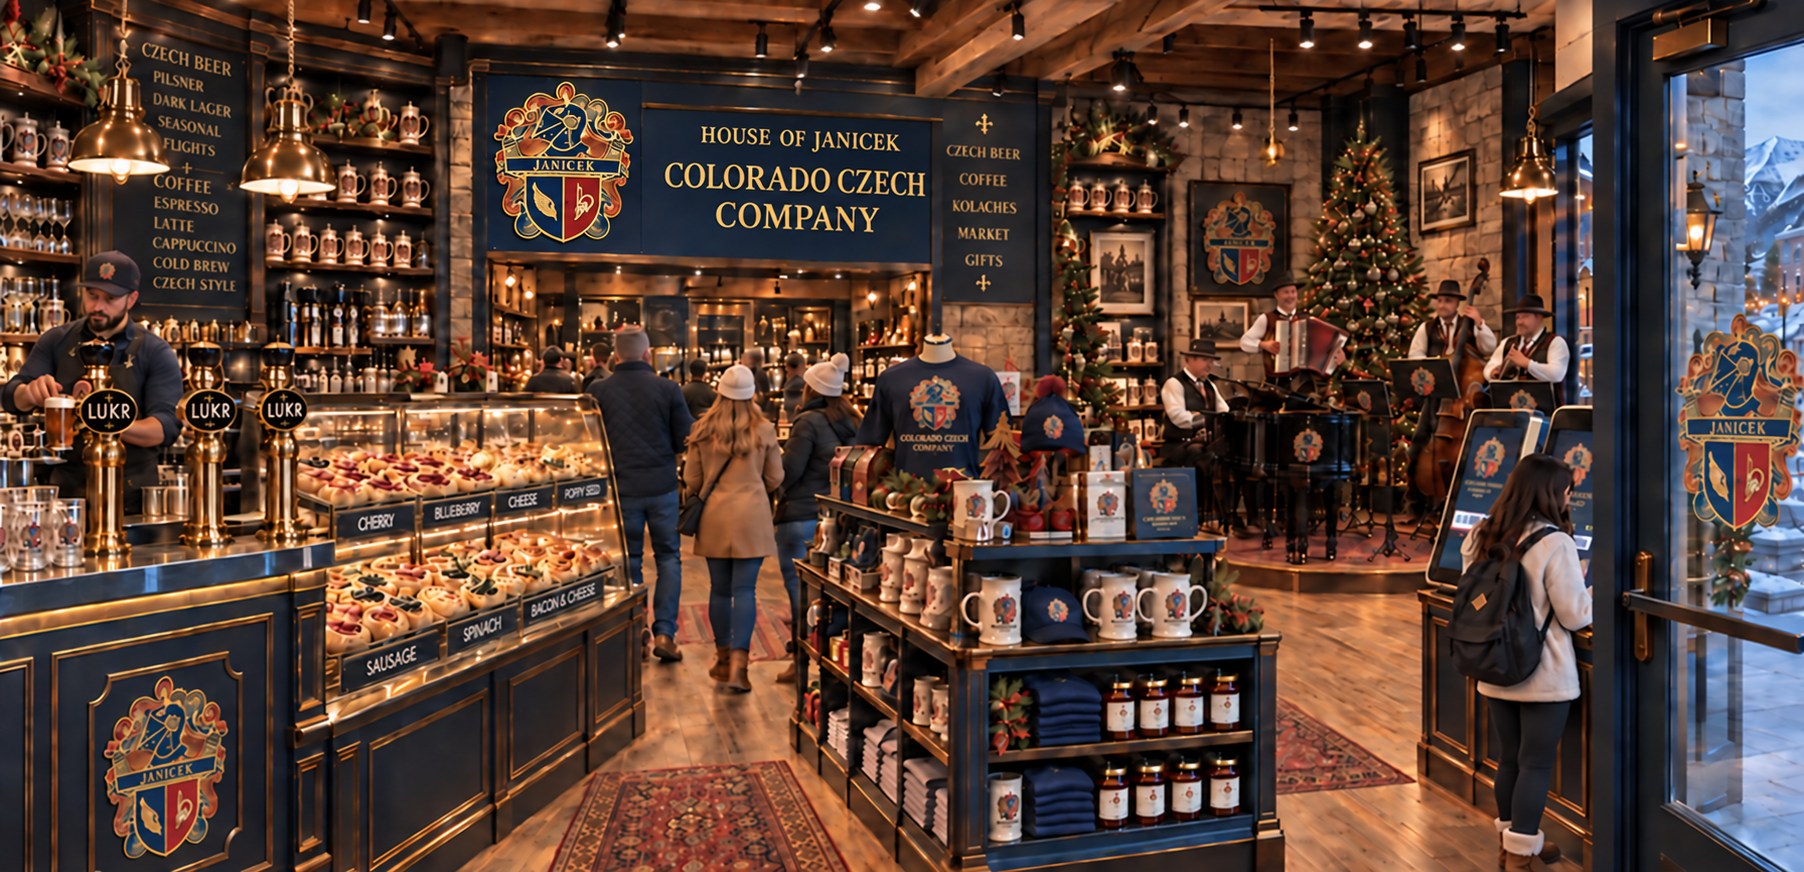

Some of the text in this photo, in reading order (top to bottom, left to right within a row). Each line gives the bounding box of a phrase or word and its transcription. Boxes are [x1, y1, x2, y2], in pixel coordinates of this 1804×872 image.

[141, 42, 232, 77] CZECH BEER
[153, 70, 204, 93] PILSNER
[153, 92, 232, 118] DARK LAGER
[158, 115, 221, 138] SEASONAL
[163, 137, 216, 157] FLIGHTS
[701, 126, 901, 152] HOUSE OF JANICEK
[946, 144, 1021, 160] CZECH BEER
[533, 160, 595, 171] JANICEK
[153, 174, 212, 195] COFFEE
[664, 162, 926, 197] COLORADO CZECH
[959, 172, 1008, 187] COFFEE
[154, 196, 219, 215] ESPRESSO
[952, 200, 1017, 214] KOLACHES
[154, 216, 195, 233] LATTE
[715, 202, 880, 233] COMPANY
[958, 227, 1010, 241] MARKET
[152, 236, 237, 254] CAPPUCCINO
[153, 256, 230, 273] COLD BREW
[965, 254, 1003, 267] GIFTS
[152, 276, 236, 292] CZECH STYLE
[88, 403, 131, 419] LUKR
[191, 403, 230, 419] LUKR
[267, 402, 303, 418] LUKR
[1709, 421, 1766, 435] JANICEK
[508, 493, 537, 508] CHEESE
[434, 502, 480, 520] BLUEBERRY
[358, 513, 395, 532] CHERRY
[531, 596, 559, 618] BACON
[567, 583, 596, 604] CHEESE
[463, 616, 502, 642] SPINACH
[366, 646, 417, 677] SAUSAGE
[140, 763, 193, 784] JANICEK
